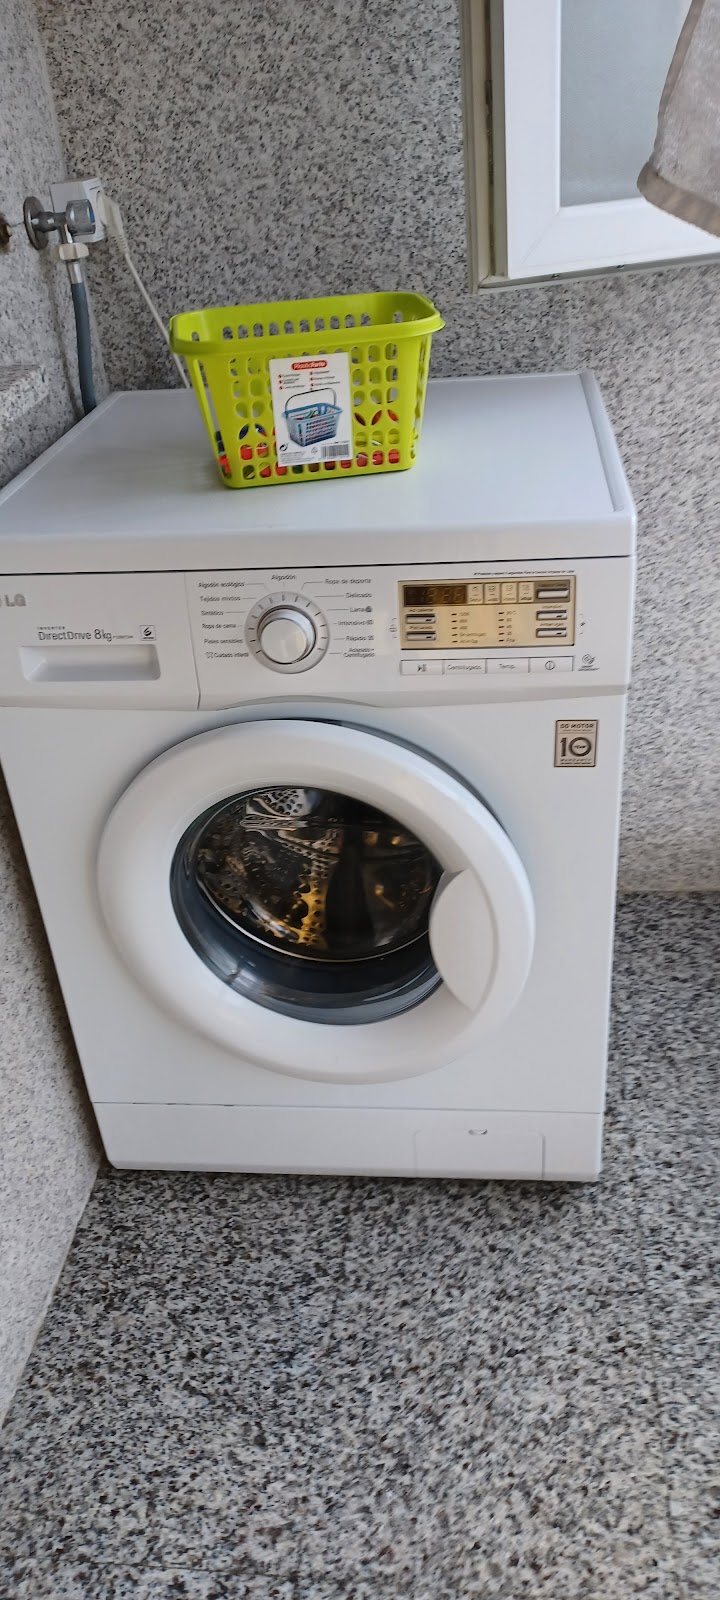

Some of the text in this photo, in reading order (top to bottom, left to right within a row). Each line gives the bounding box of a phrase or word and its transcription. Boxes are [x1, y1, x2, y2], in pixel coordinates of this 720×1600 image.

[5, 593, 27, 607] LG
[94, 629, 113, 642] 8kg
[560, 736, 592, 757] 10
